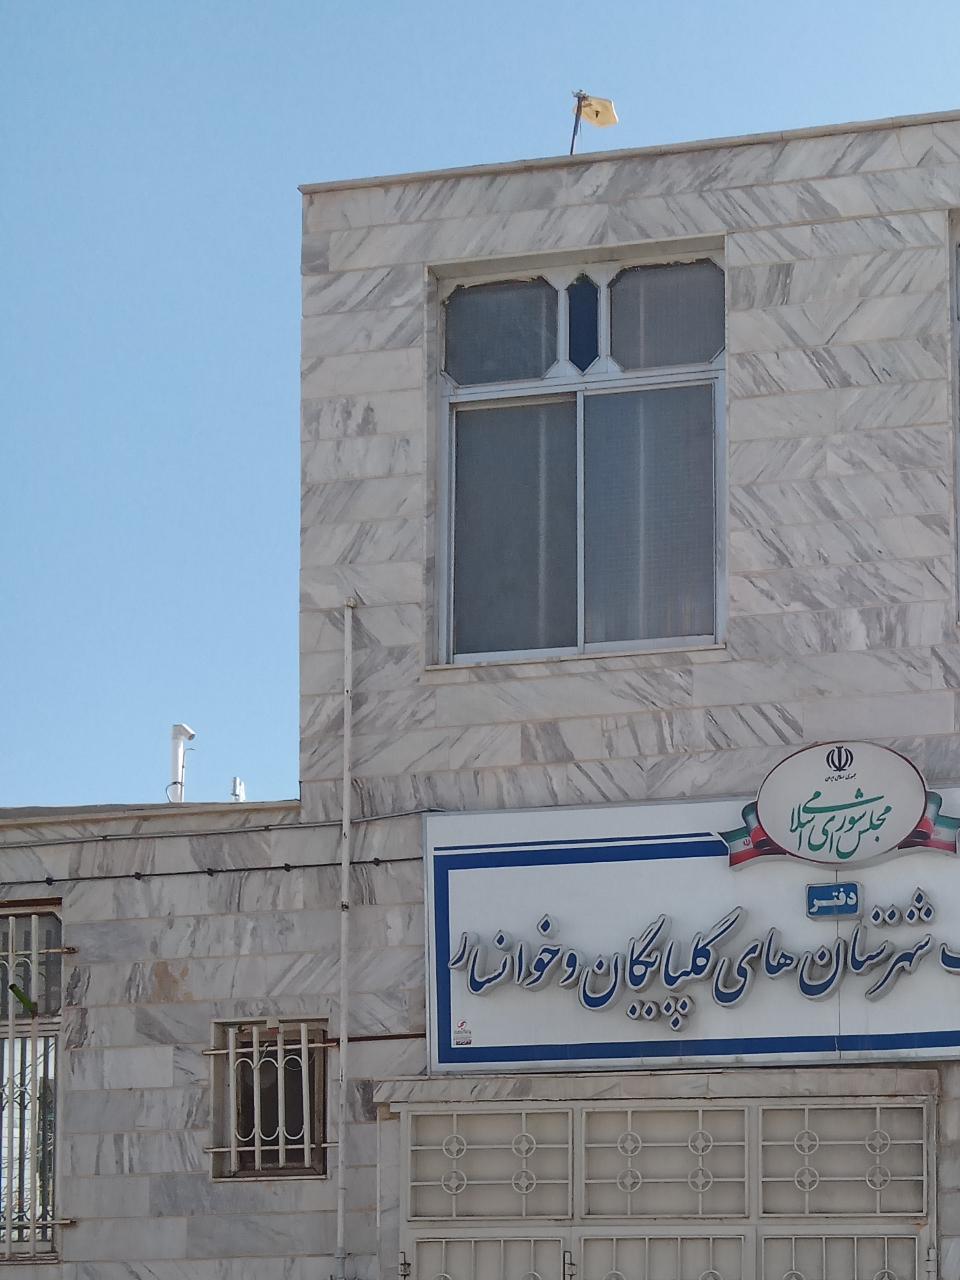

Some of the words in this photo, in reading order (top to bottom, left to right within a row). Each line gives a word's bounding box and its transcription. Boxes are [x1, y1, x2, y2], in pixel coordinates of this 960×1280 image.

[789, 790, 885, 852] اسلامی
[807, 787, 867, 854] شورای
[836, 805, 892, 860] مجلس
[808, 888, 858, 914] دفتر
[578, 905, 746, 1032] گلپایگان
[712, 926, 800, 1008] های
[798, 886, 935, 1002] شهرستان
